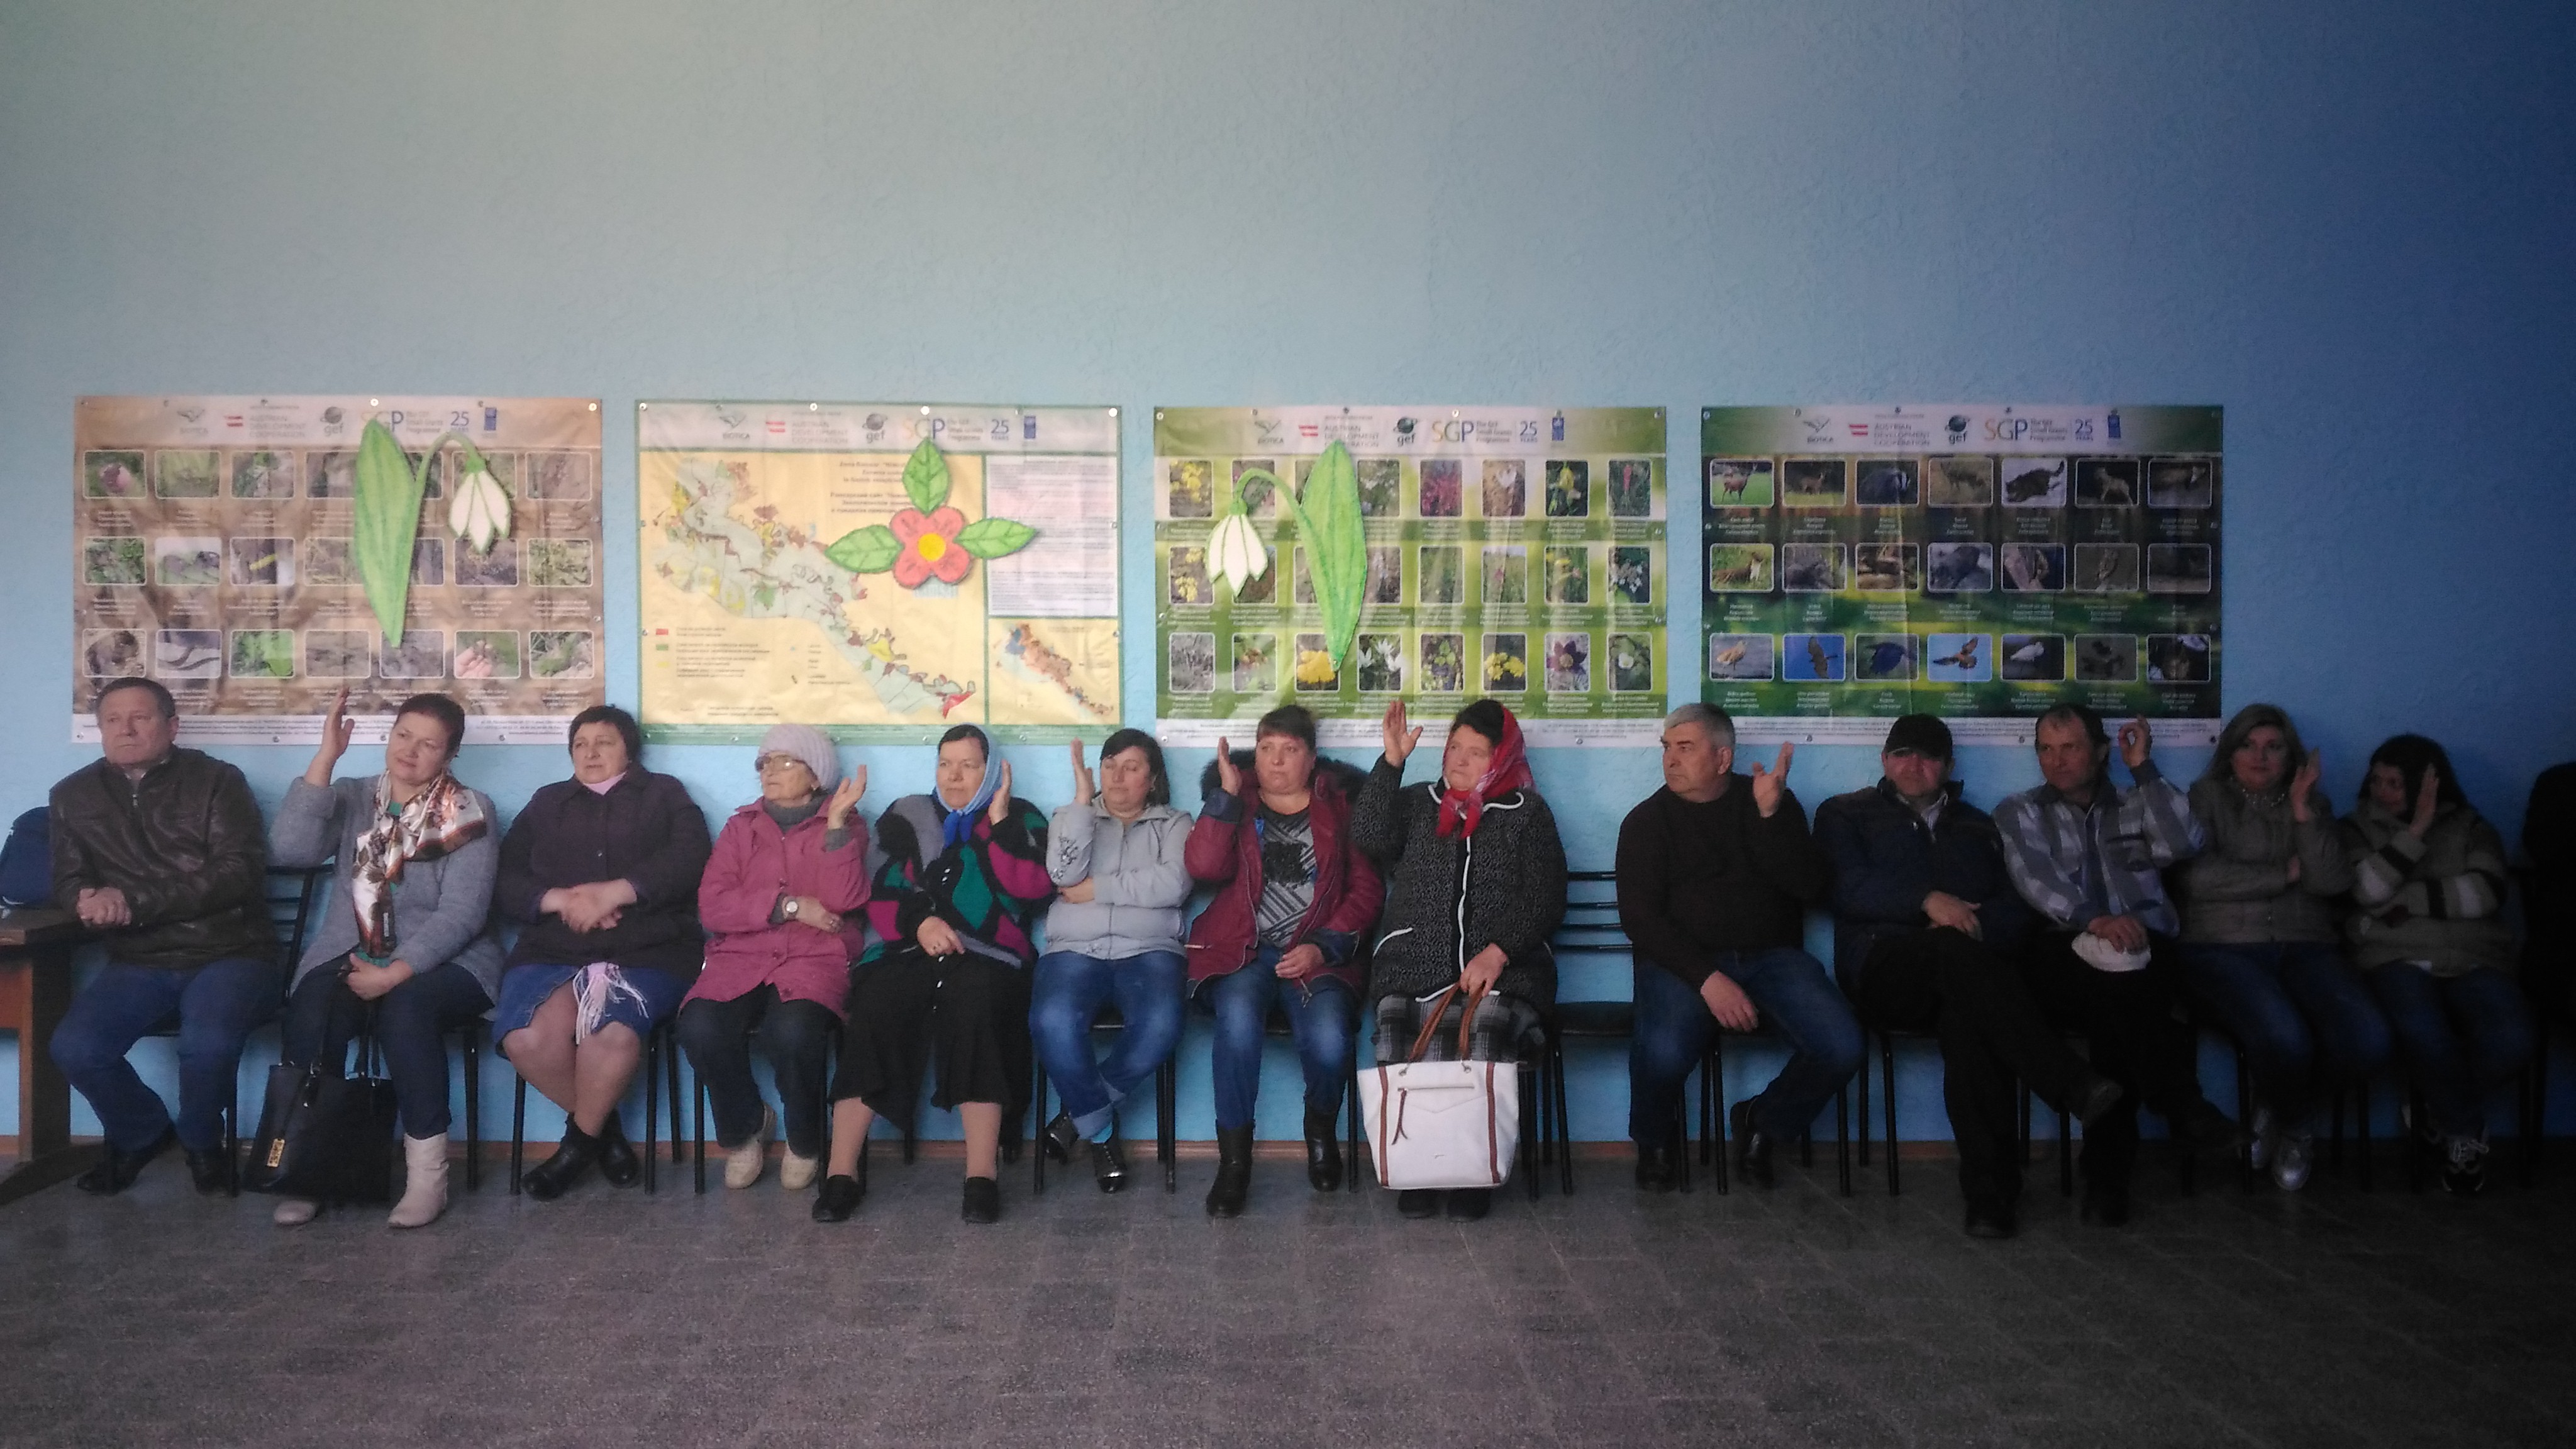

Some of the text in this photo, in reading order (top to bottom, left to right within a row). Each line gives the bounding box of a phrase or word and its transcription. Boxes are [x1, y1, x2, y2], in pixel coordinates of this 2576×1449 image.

[450, 411, 469, 426] 25
[324, 423, 344, 436] gef
[902, 418, 946, 440] SGP
[991, 419, 1009, 435] 25
[1431, 421, 1474, 443] SGP
[1519, 421, 1538, 436] 25
[1985, 418, 2028, 440] SGP
[2075, 418, 2094, 435] 25
[866, 430, 886, 444] gef
[1397, 433, 1416, 447] gef
[1948, 432, 1968, 445] gef
